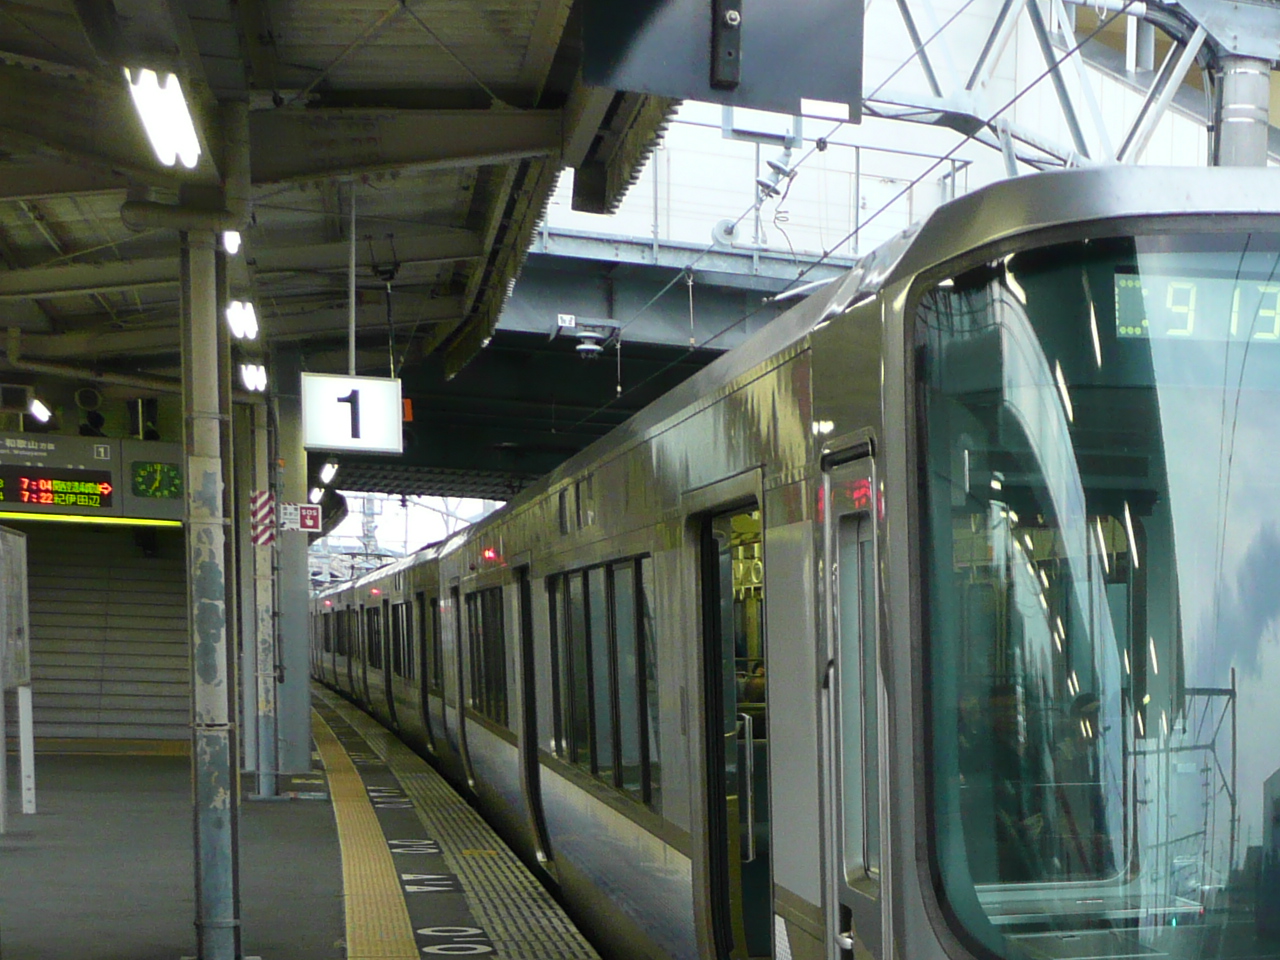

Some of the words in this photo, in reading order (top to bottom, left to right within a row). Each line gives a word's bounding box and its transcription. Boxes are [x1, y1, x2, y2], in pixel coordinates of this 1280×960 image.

[337, 389, 361, 439] 1
[20, 477, 52, 491] 7:04
[301, 509, 318, 517] SOS
